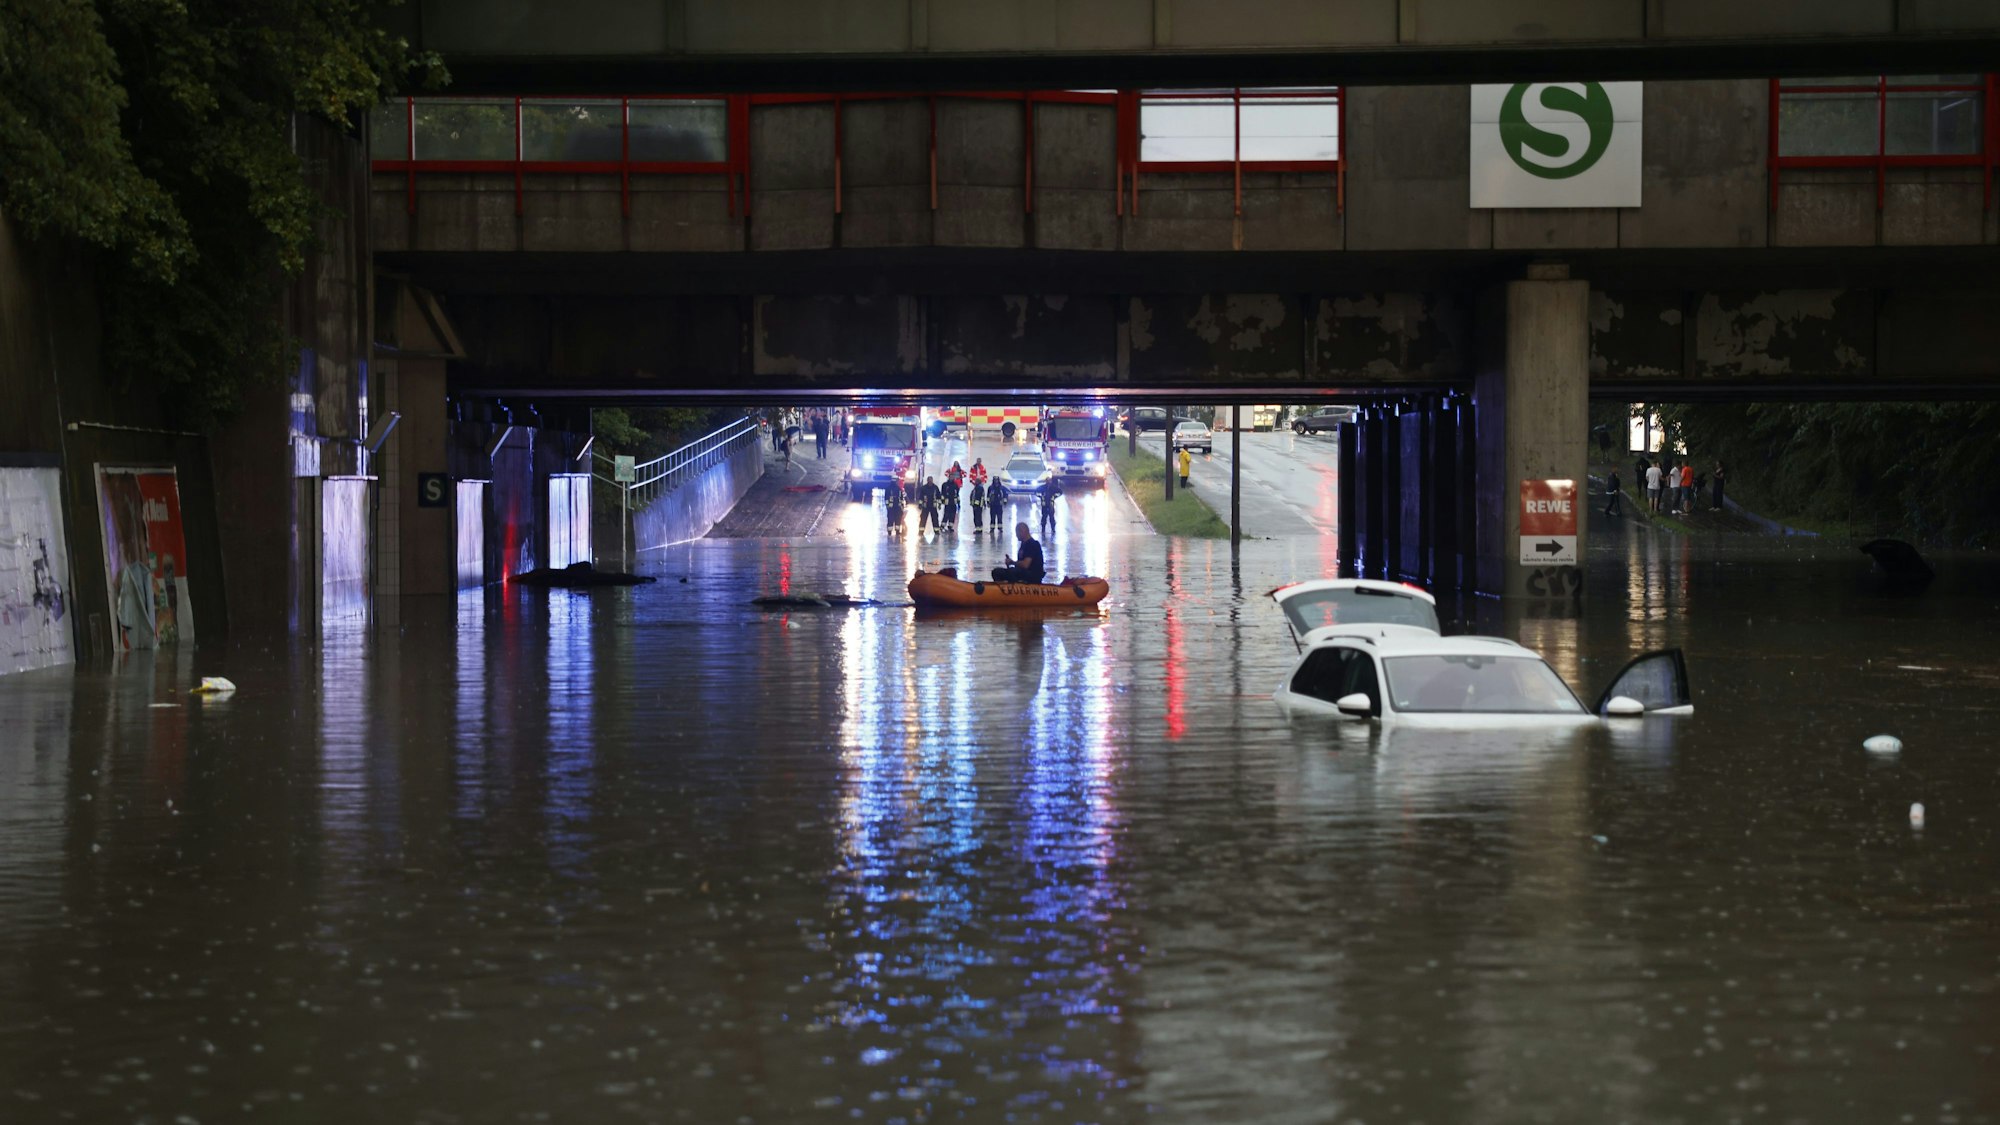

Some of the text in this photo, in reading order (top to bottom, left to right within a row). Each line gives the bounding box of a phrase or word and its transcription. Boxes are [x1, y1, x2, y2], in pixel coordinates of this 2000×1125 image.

[1520, 83, 1592, 169] S
[427, 478, 442, 501] S
[1526, 499, 1571, 514] REWE
